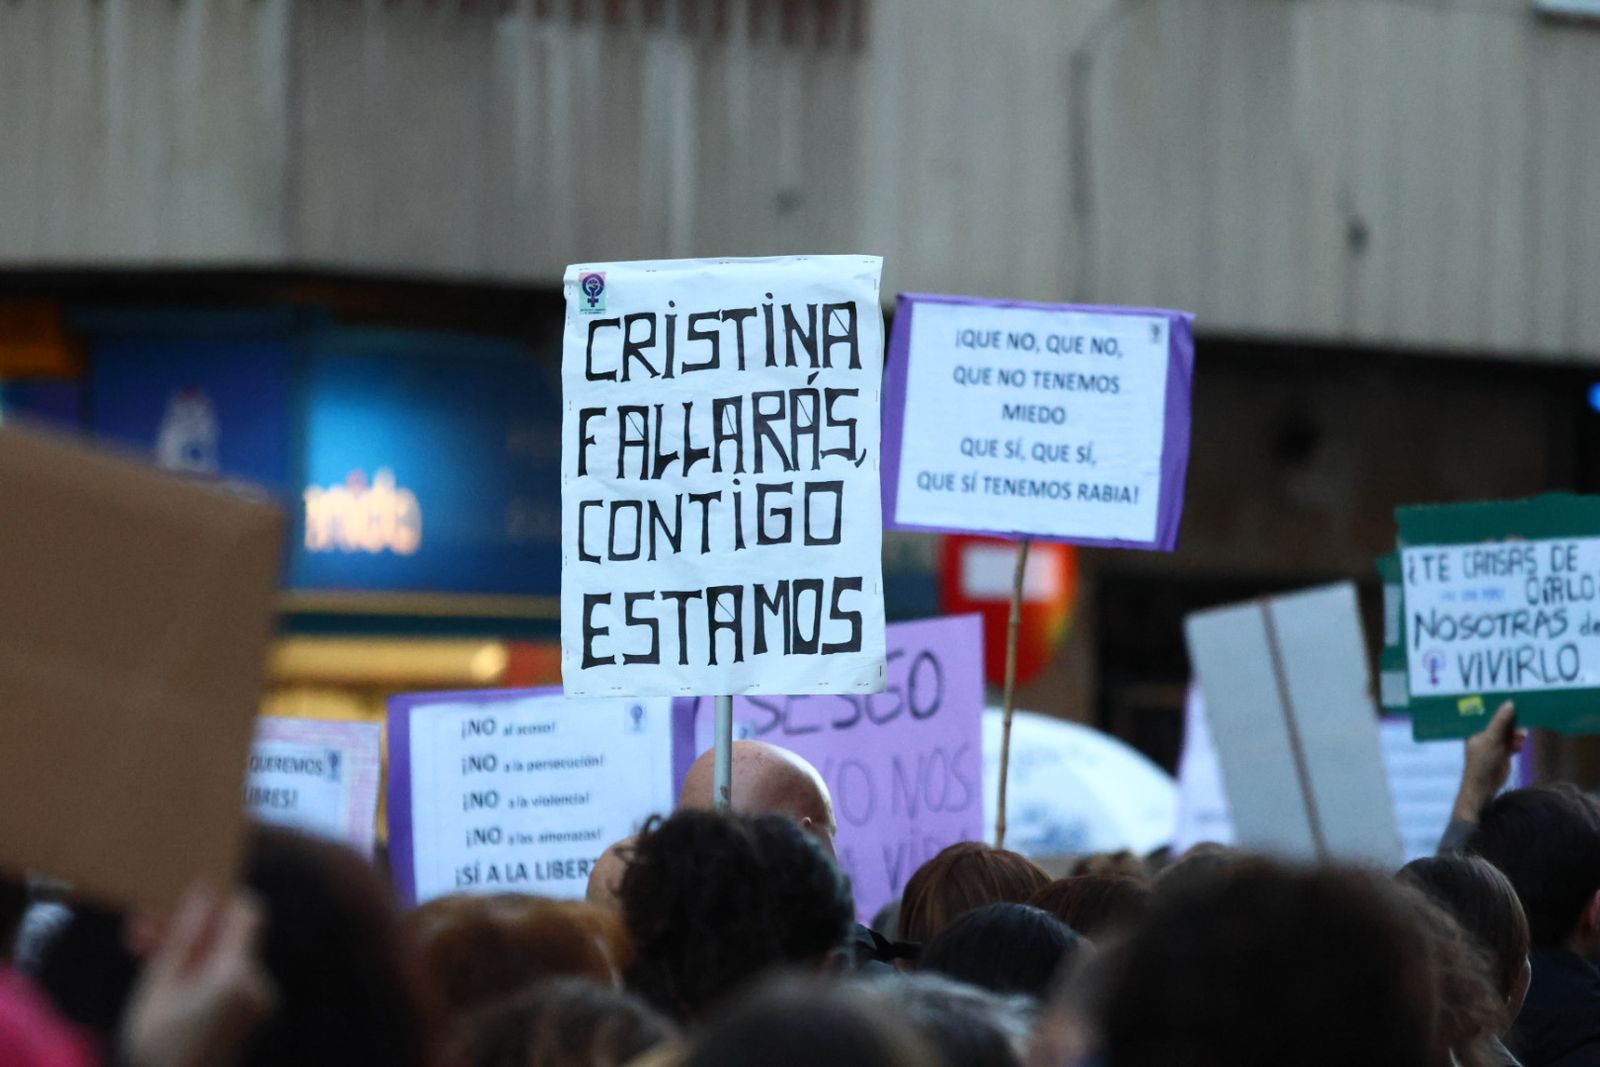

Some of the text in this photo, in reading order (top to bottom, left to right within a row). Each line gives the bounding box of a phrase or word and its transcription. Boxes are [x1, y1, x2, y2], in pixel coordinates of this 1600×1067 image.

[585, 292, 862, 382] CRISTINA
[955, 329, 1123, 359] ¡QUE NO, QUE NO,
[953, 365, 1120, 394] QUE NO TENEMOS
[577, 371, 866, 480] FALLARÁS,
[1002, 404, 1066, 425] MIEDO
[961, 436, 1097, 466] QUE SÍ, QUE SÍ,
[917, 469, 1140, 505] QUE SÍ TENEMOS RABIA!
[578, 479, 844, 562] CONTIGO
[1551, 544, 1578, 573] DE
[581, 576, 863, 669] ESTAMOS
[1414, 606, 1569, 650] NOSOTRAS
[462, 718, 497, 740] ¡NO
[462, 754, 498, 776] ¡NO
[513, 760, 523, 772] la
[891, 741, 974, 821] NOS
[463, 790, 499, 812] ¡NO
[516, 796, 528, 808] la
[466, 827, 502, 849] ¡NO
[516, 833, 534, 845] las
[455, 859, 480, 887] ¡SÍ
[486, 864, 500, 883] A
[505, 861, 528, 883] LA
